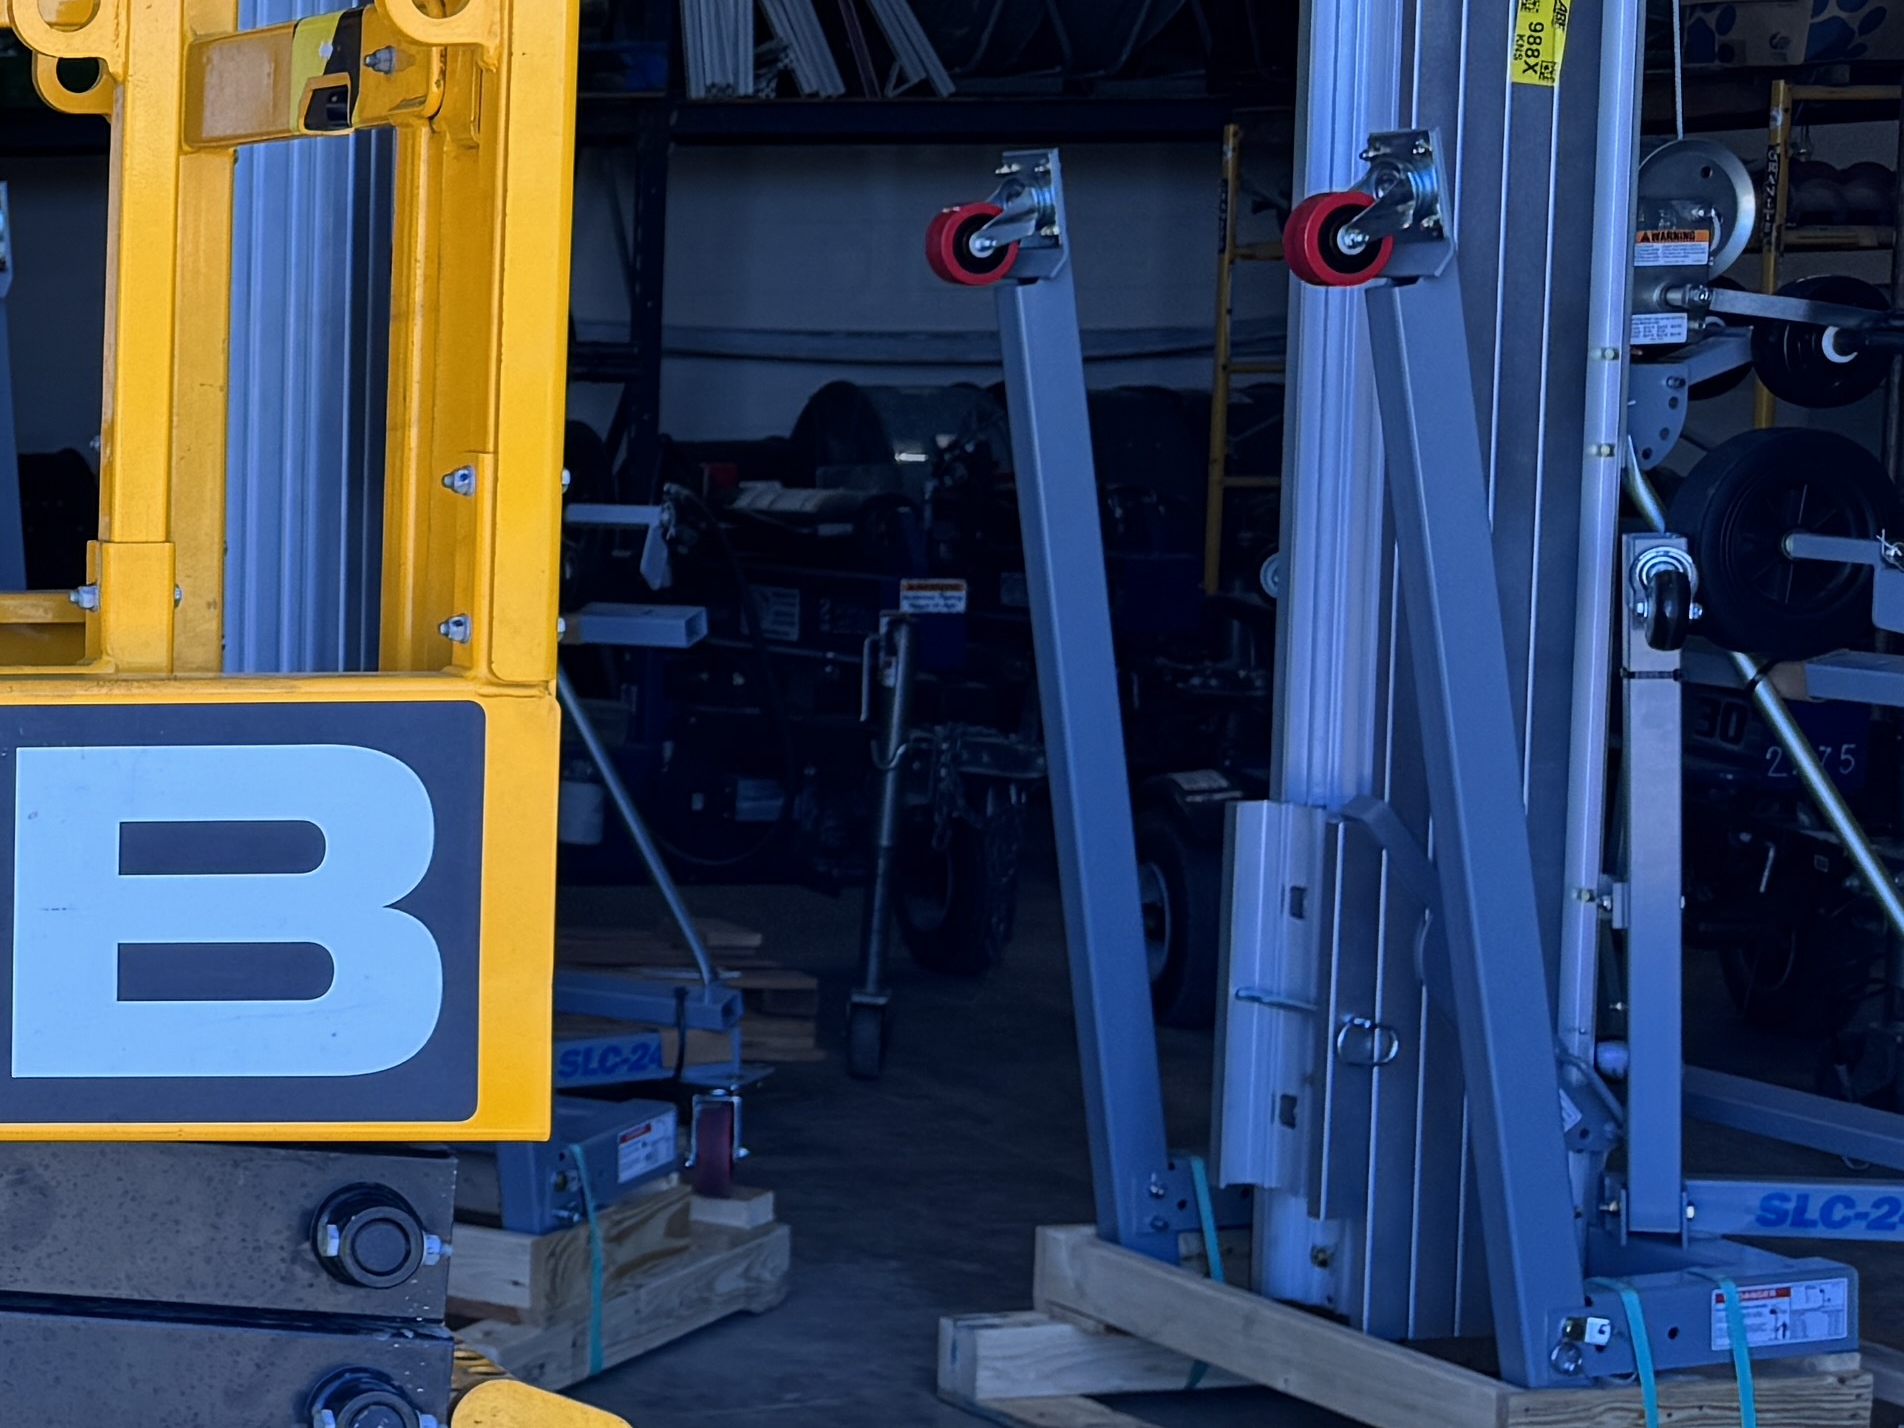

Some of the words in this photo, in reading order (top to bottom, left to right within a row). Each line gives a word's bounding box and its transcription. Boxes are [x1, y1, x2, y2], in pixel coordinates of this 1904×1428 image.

[1513, 33, 1525, 61] KNS
[1522, 21, 1545, 75] 988X
[1651, 230, 1696, 244] WARNING
[1765, 743, 1857, 779] 275
[1755, 1191, 1904, 1231] SLC-2
